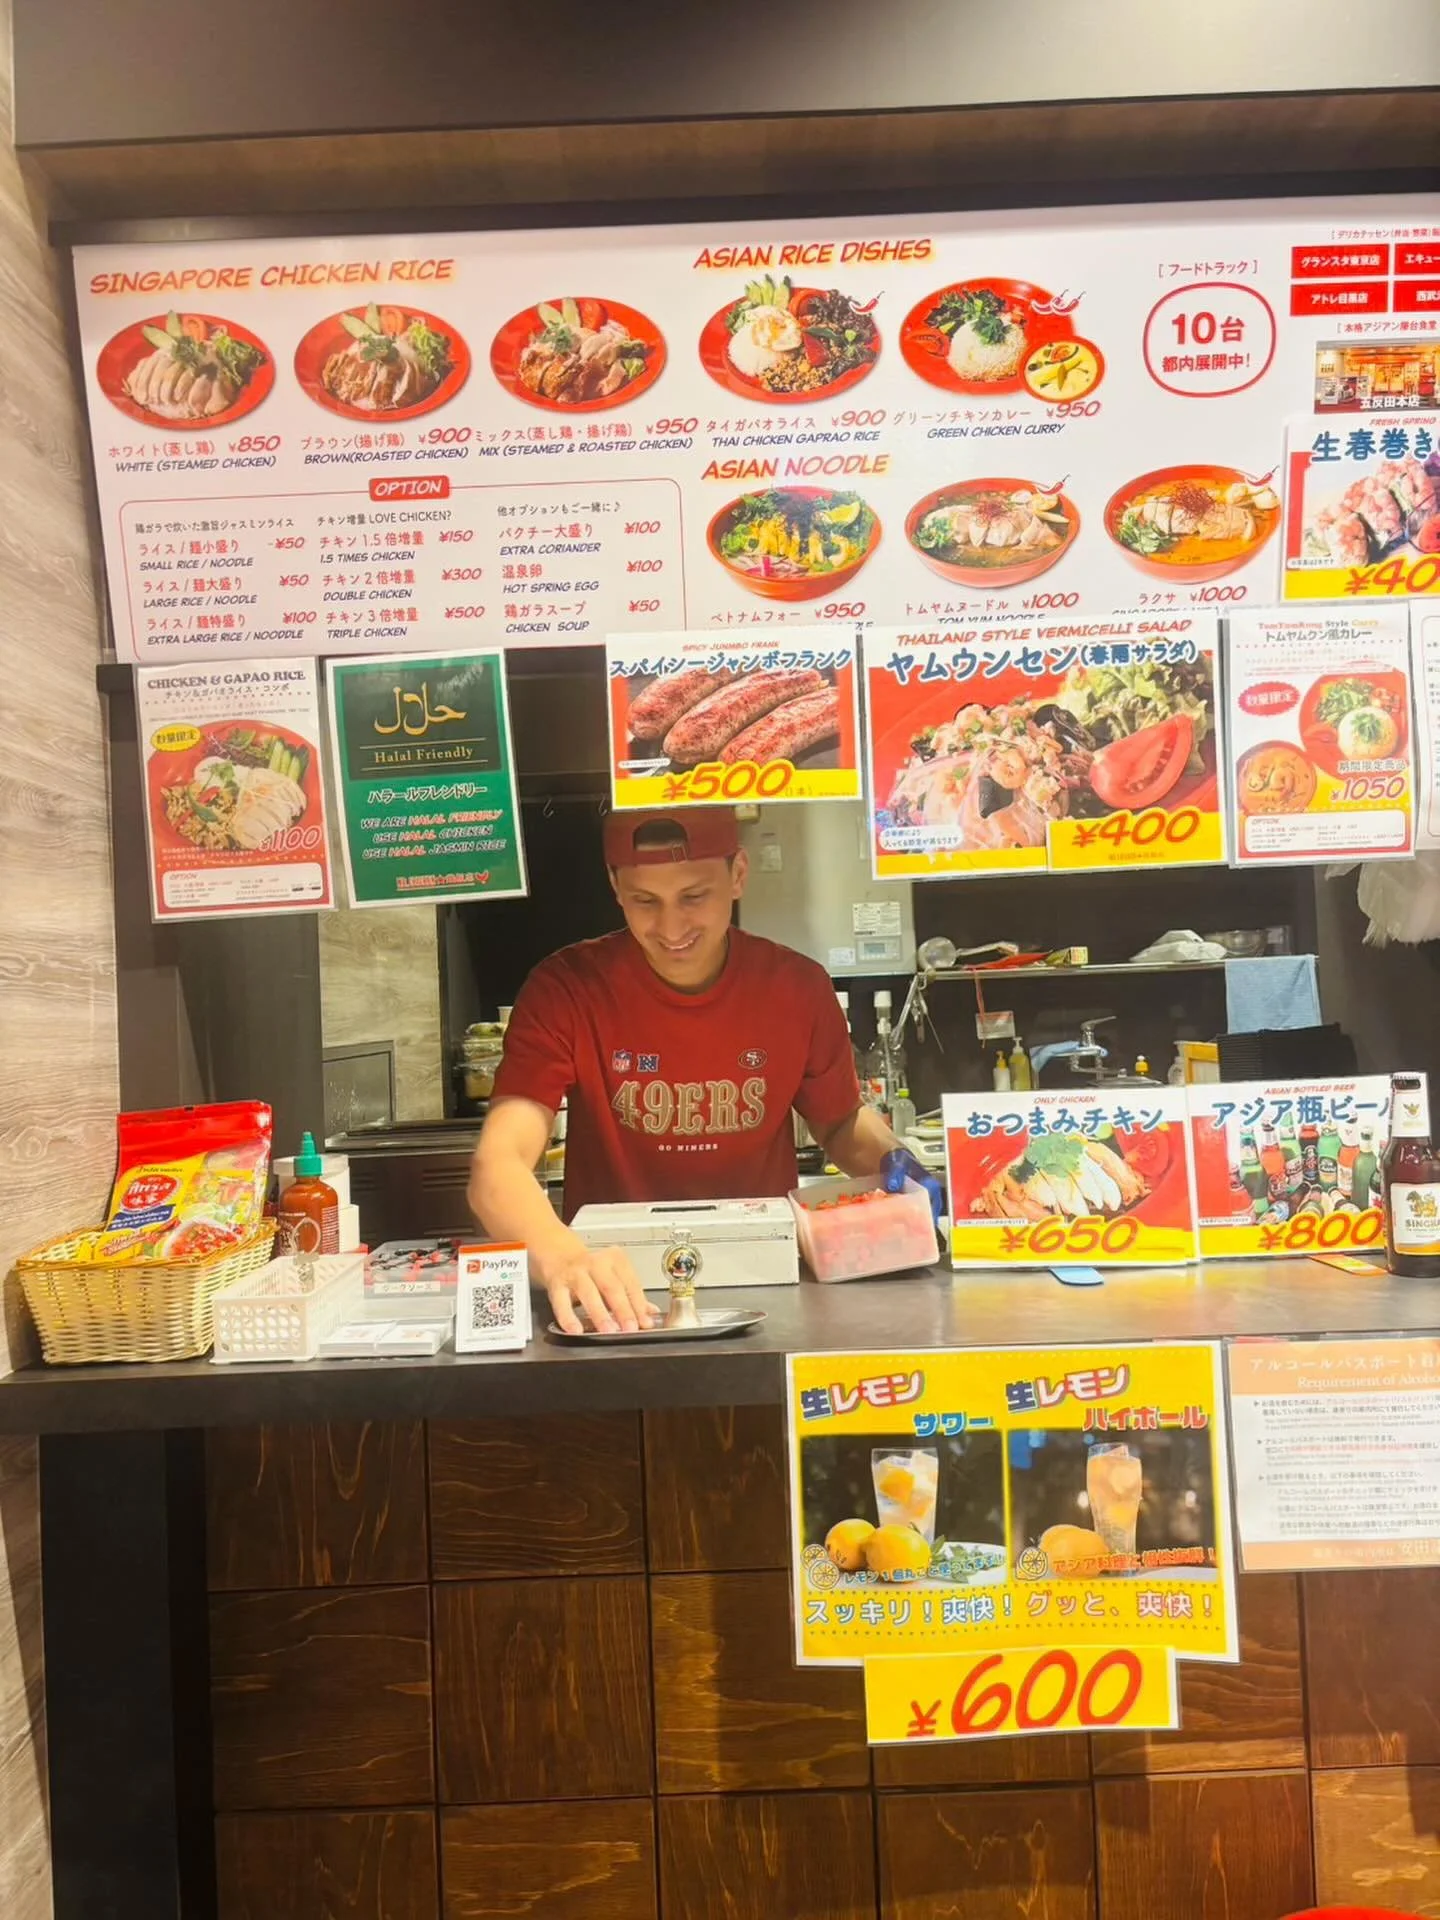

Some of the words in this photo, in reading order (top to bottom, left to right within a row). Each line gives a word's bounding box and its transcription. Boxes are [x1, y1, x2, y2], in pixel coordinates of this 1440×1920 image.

[693, 245, 772, 269] ASIAN
[779, 243, 834, 266] RICE
[840, 239, 932, 263] DISHES
[90, 267, 252, 294] SINGAPORE
[261, 261, 381, 287] CHICKEN
[388, 259, 455, 281] RICE
[1171, 311, 1245, 345] 10台
[1359, 395, 1420, 410] 五反田本店
[831, 408, 887, 427] ¥900
[893, 408, 1031, 425] グリーンチキンカレー
[1046, 400, 1101, 419] ¥950
[646, 417, 699, 435] ¥950
[927, 426, 970, 439] GREEN
[972, 424, 1022, 437] CHICKEN
[1024, 422, 1065, 435] CURRY
[228, 435, 281, 454] ¥850
[418, 427, 472, 445] ¥900
[711, 436, 740, 448] THAI
[743, 433, 794, 446] CHICKEN
[796, 431, 852, 445] GAPRAO
[854, 430, 881, 442] RICE
[1311, 428, 1433, 463] 生春巻き
[304, 450, 412, 465] BROWN(ROASTED
[415, 447, 469, 460] CHICKEN)
[478, 446, 500, 457] MIX
[503, 443, 564, 457] (STEAMED
[568, 443, 576, 453] &
[579, 440, 636, 453] ROASTED
[638, 437, 693, 451] CHICKEN)
[115, 461, 154, 473] WHITE
[157, 458, 219, 472] (STEAMED
[222, 455, 276, 469] CHICKEN)
[700, 457, 779, 480] ASIAN
[784, 453, 890, 477] NOODLE
[374, 480, 443, 497] OPTION
[369, 512, 396, 524] LOVE
[399, 510, 452, 523] CHICKEN?
[319, 534, 357, 548] チキン
[363, 533, 382, 547] 1.5
[385, 530, 425, 546] 倍増量
[439, 529, 473, 543] ¥150
[499, 522, 594, 539] パクチー大盛り
[623, 520, 660, 534] ¥100
[139, 542, 176, 556] ライス
[319, 553, 335, 564] 1.5
[337, 551, 369, 563] TIMES
[371, 550, 415, 562] CHICKEN
[500, 544, 536, 556] EXTRA
[538, 542, 601, 555] CORIANDER
[139, 560, 175, 572] SMALL
[177, 559, 199, 570] RICE
[210, 557, 253, 568] NOODLE
[502, 563, 543, 579] 温泉卵
[626, 559, 663, 573] ¥100
[144, 580, 180, 594] ライス
[279, 575, 309, 587] ¥50
[323, 572, 360, 586] チキン
[364, 572, 373, 585] 2
[376, 569, 415, 585] 倍増量
[441, 568, 482, 581] ¥300
[323, 591, 366, 602] DOUBLE
[368, 589, 412, 600] CHICKEN
[503, 583, 526, 594] HOT
[529, 582, 571, 593] SPRING
[574, 580, 600, 592] EGG
[1138, 592, 1176, 605] ラクサ
[1189, 585, 1247, 602] ¥1000
[143, 598, 177, 609] LARGE
[180, 596, 203, 608] RICE
[213, 594, 257, 606] NOODLE
[504, 600, 587, 619] 鶏ガラスープ
[628, 599, 660, 613] ¥50
[906, 599, 1009, 616] トムヤムヌードル
[1022, 591, 1079, 609] ¥1000
[147, 617, 183, 631] ライス
[282, 611, 317, 625] ¥100
[326, 610, 363, 624] チキン
[368, 610, 376, 623] 3
[380, 607, 418, 623] 倍増量
[444, 606, 485, 619] ¥500
[711, 610, 801, 624] ベトナムフォー
[814, 602, 866, 619] ¥950
[327, 627, 361, 639] TRIPLE
[364, 626, 407, 638] CHICKEN
[505, 622, 550, 634] CHICKEN
[557, 620, 590, 632] SOUP
[896, 631, 977, 647] THAILAND
[982, 627, 1031, 643] STYLE
[1036, 622, 1133, 640] VERMICELLI
[1136, 618, 1192, 633] SALAD
[148, 634, 180, 646] EXTRA
[183, 632, 218, 644] LARGE
[220, 631, 243, 643] RICE
[610, 648, 853, 678] スパイシージャンボフランク
[147, 676, 207, 690] CHICKEN
[210, 675, 221, 686] &
[224, 672, 270, 684] GAPAO
[274, 670, 306, 682] RICE
[374, 751, 412, 764] Halal
[416, 747, 473, 761] Friendly
[661, 761, 795, 801] ¥500
[367, 782, 488, 804] ハラールフレンドリー
[361, 818, 380, 829] WE
[381, 816, 407, 828] ARE
[1072, 807, 1201, 850] ¥400
[611, 1076, 768, 1135] 49ERS
[1033, 1096, 1057, 1105] ONLY
[1058, 1095, 1096, 1105] CHICKEN
[967, 1105, 1164, 1137] おつまみチキン
[998, 1216, 1139, 1254] ¥650
[1257, 1207, 1385, 1251] ¥800
[481, 1258, 520, 1271] PayPay
[800, 1368, 925, 1421] 生レモン
[1005, 1363, 1130, 1415] 生レモン
[913, 1411, 994, 1437] サワー
[1082, 1404, 1209, 1432] ハイボール
[906, 1648, 1144, 1738] ¥600
